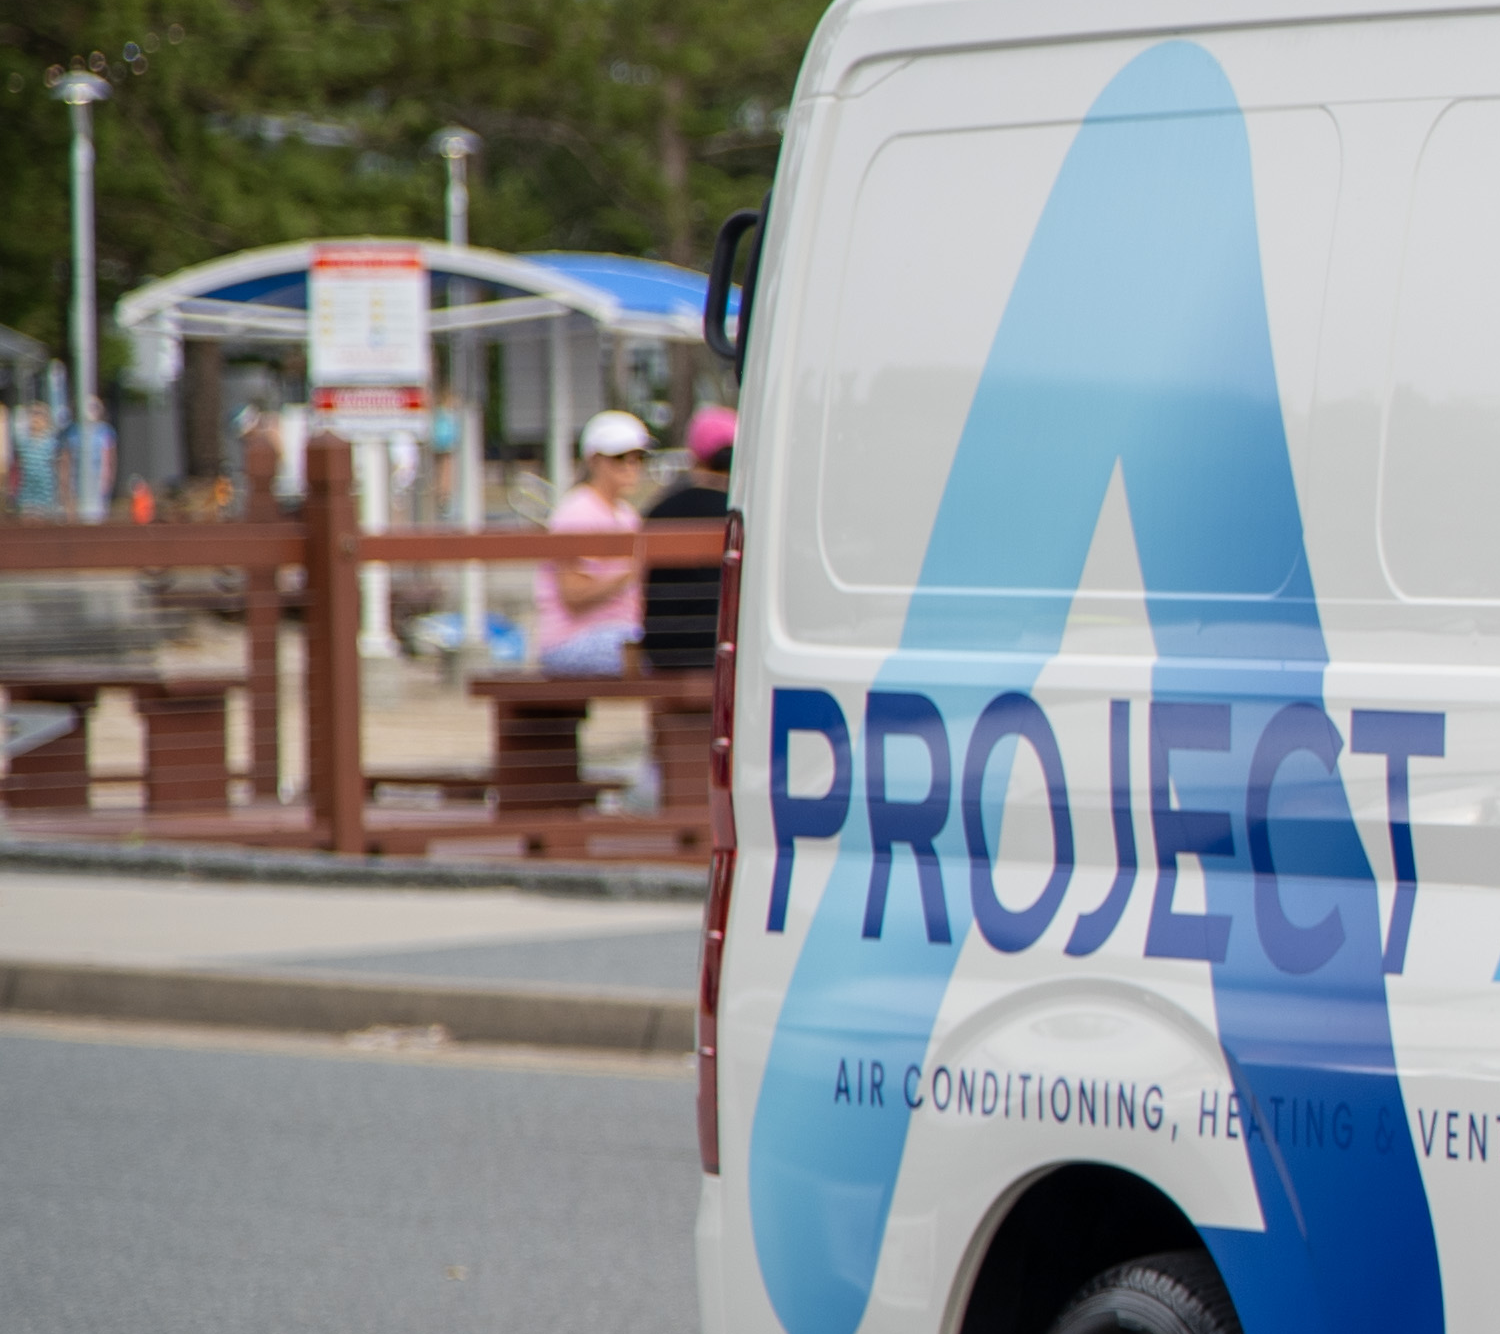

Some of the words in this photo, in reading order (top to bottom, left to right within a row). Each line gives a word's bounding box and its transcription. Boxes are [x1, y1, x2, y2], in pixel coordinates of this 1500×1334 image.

[765, 687, 1447, 977] PROJECT
[835, 1058, 885, 1108] AIR
[904, 1064, 1178, 1143] CONDITIONING,
[1199, 1089, 1353, 1151] HEATING
[1375, 1106, 1396, 1155] &
